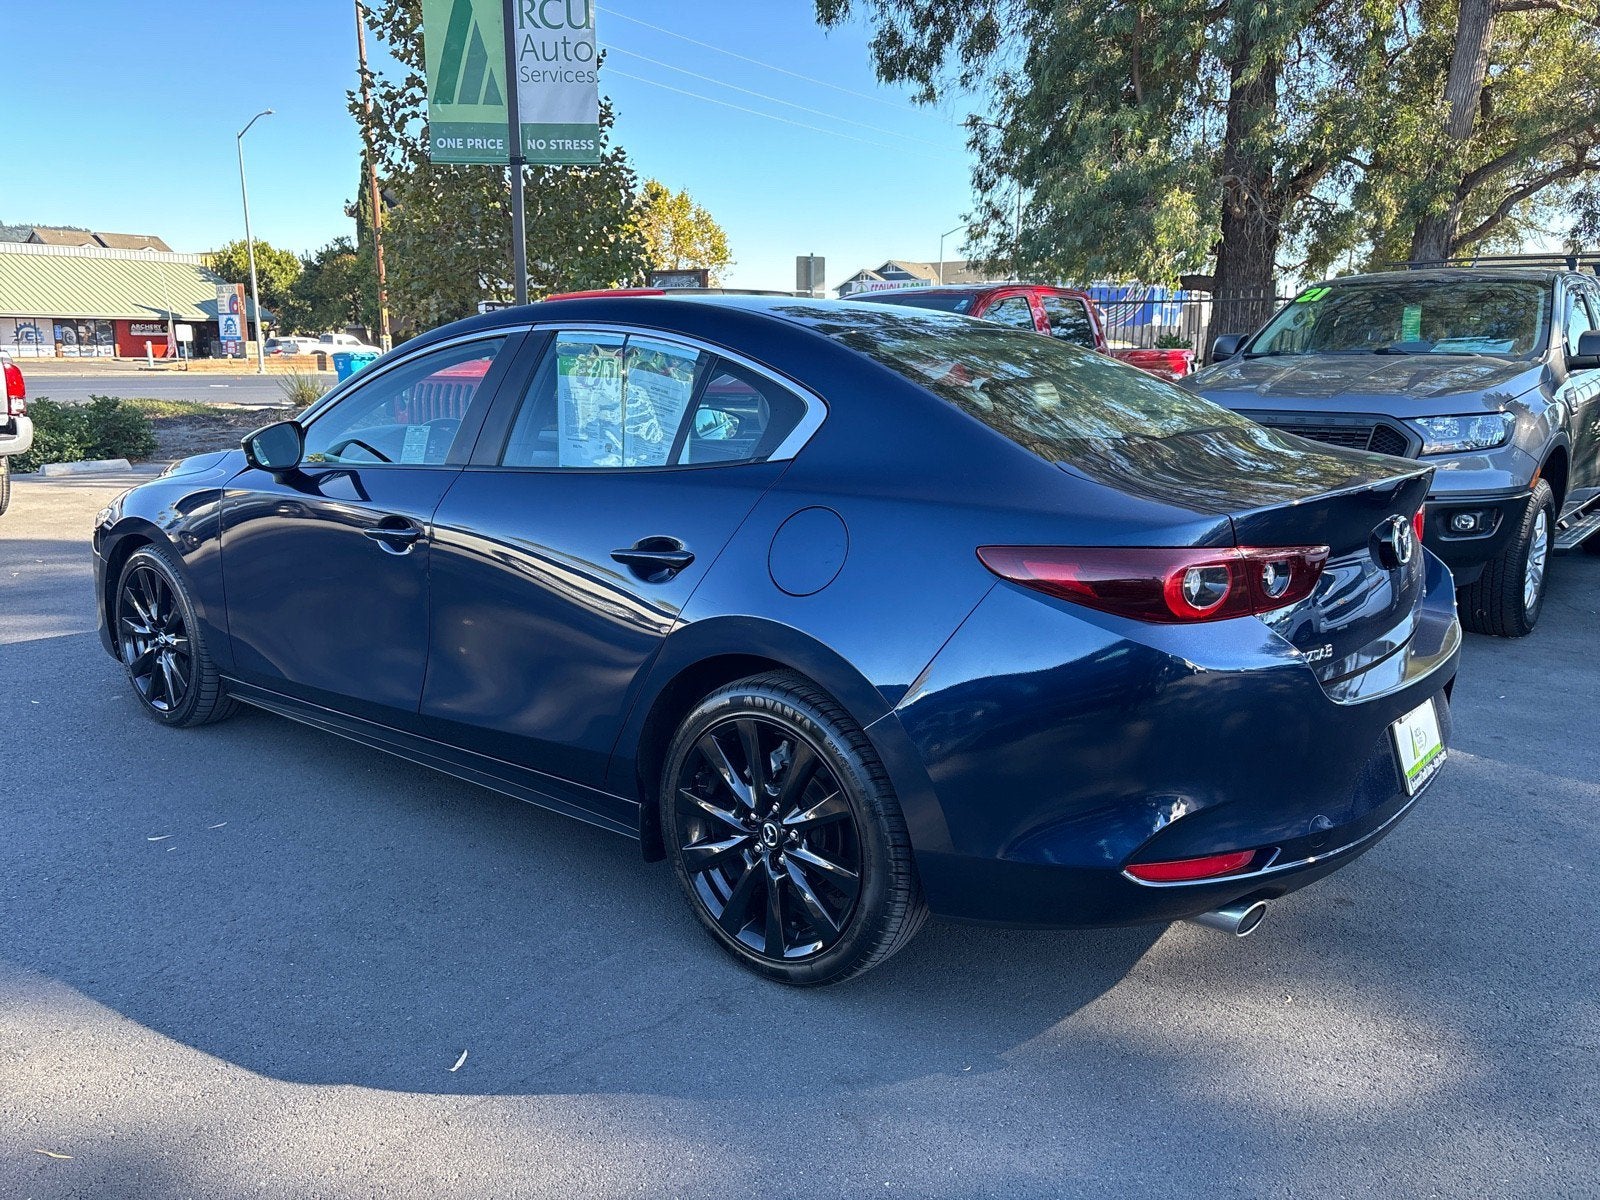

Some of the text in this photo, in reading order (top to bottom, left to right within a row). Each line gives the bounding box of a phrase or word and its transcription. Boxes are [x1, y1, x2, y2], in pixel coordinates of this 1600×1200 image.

[518, 0, 592, 30] RCU
[519, 33, 594, 62] Auto
[519, 66, 595, 84] Services
[436, 137, 504, 150] ONE PRICE
[527, 139, 595, 150] NO STRESS
[1295, 286, 1333, 303] 21
[130, 323, 162, 331] ARCHERY
[743, 695, 811, 729] ADVANTA
